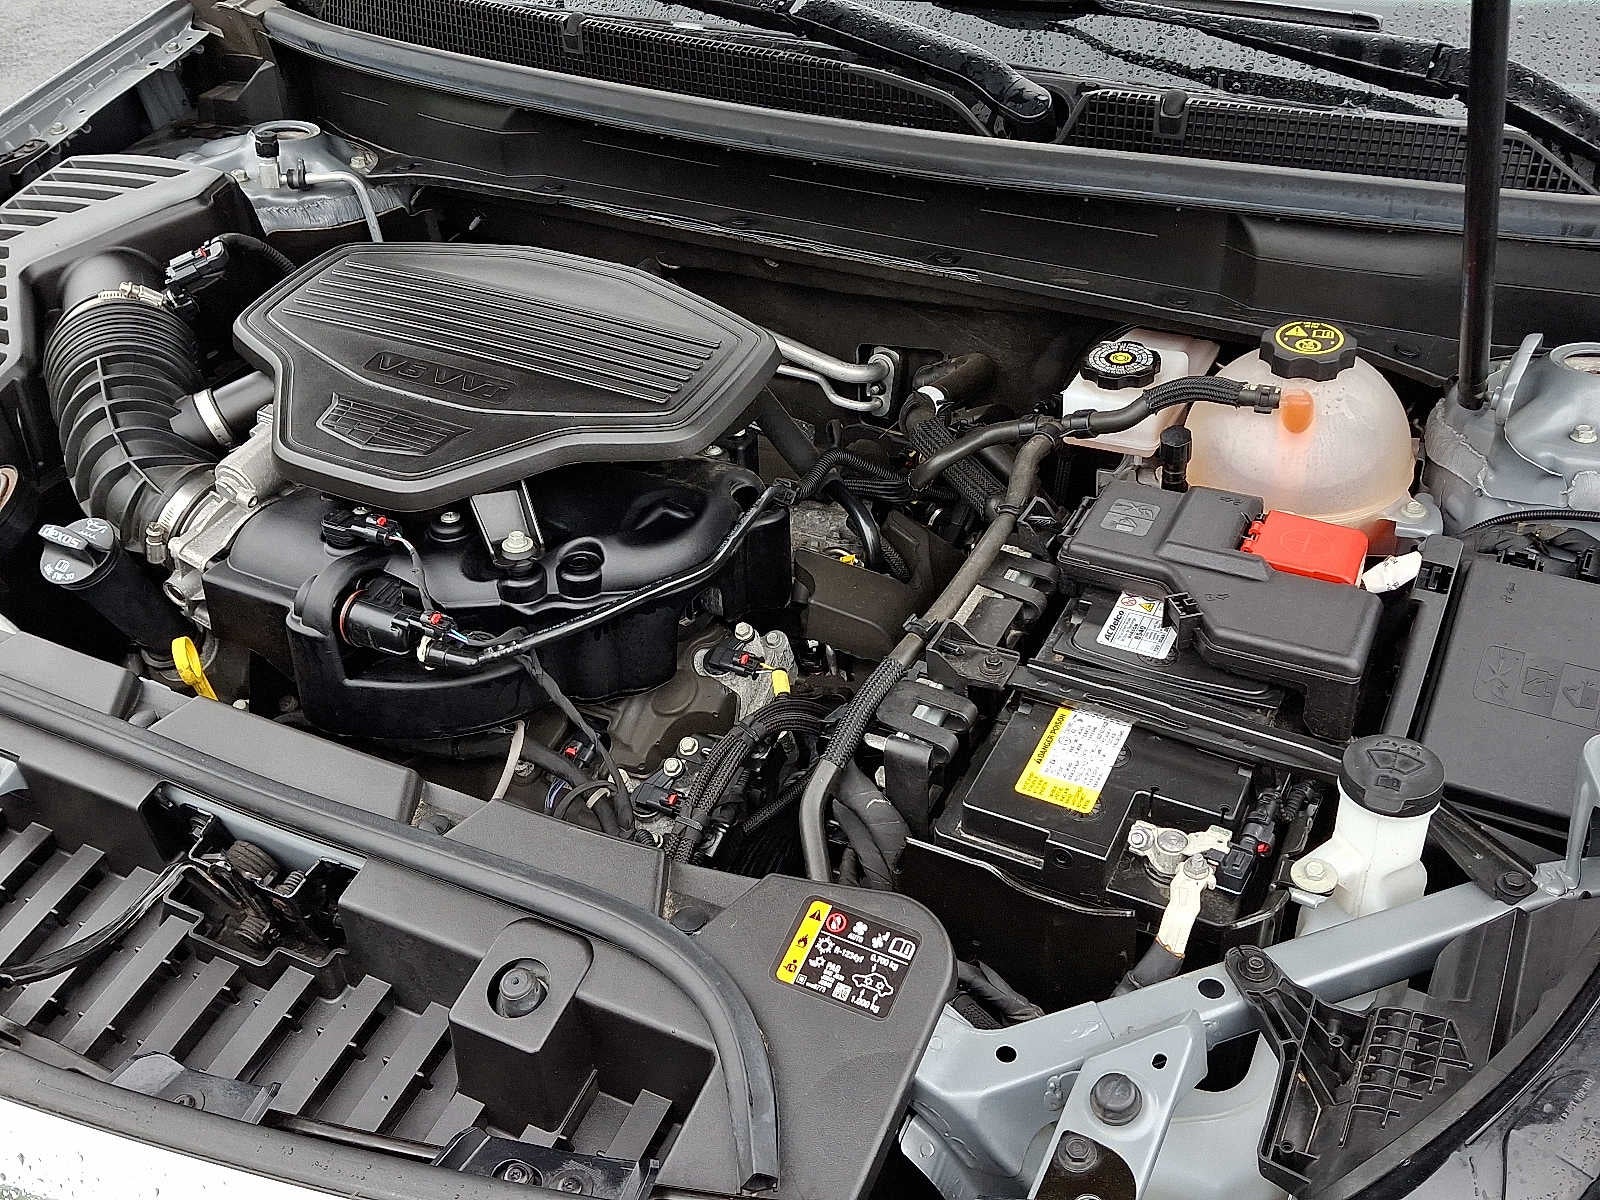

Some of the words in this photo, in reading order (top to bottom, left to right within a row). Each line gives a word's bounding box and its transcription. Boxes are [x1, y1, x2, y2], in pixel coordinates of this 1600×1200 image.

[434, 366, 510, 398] VVT
[42, 526, 82, 548] dexos
[1104, 610, 1125, 641] ACDelco
